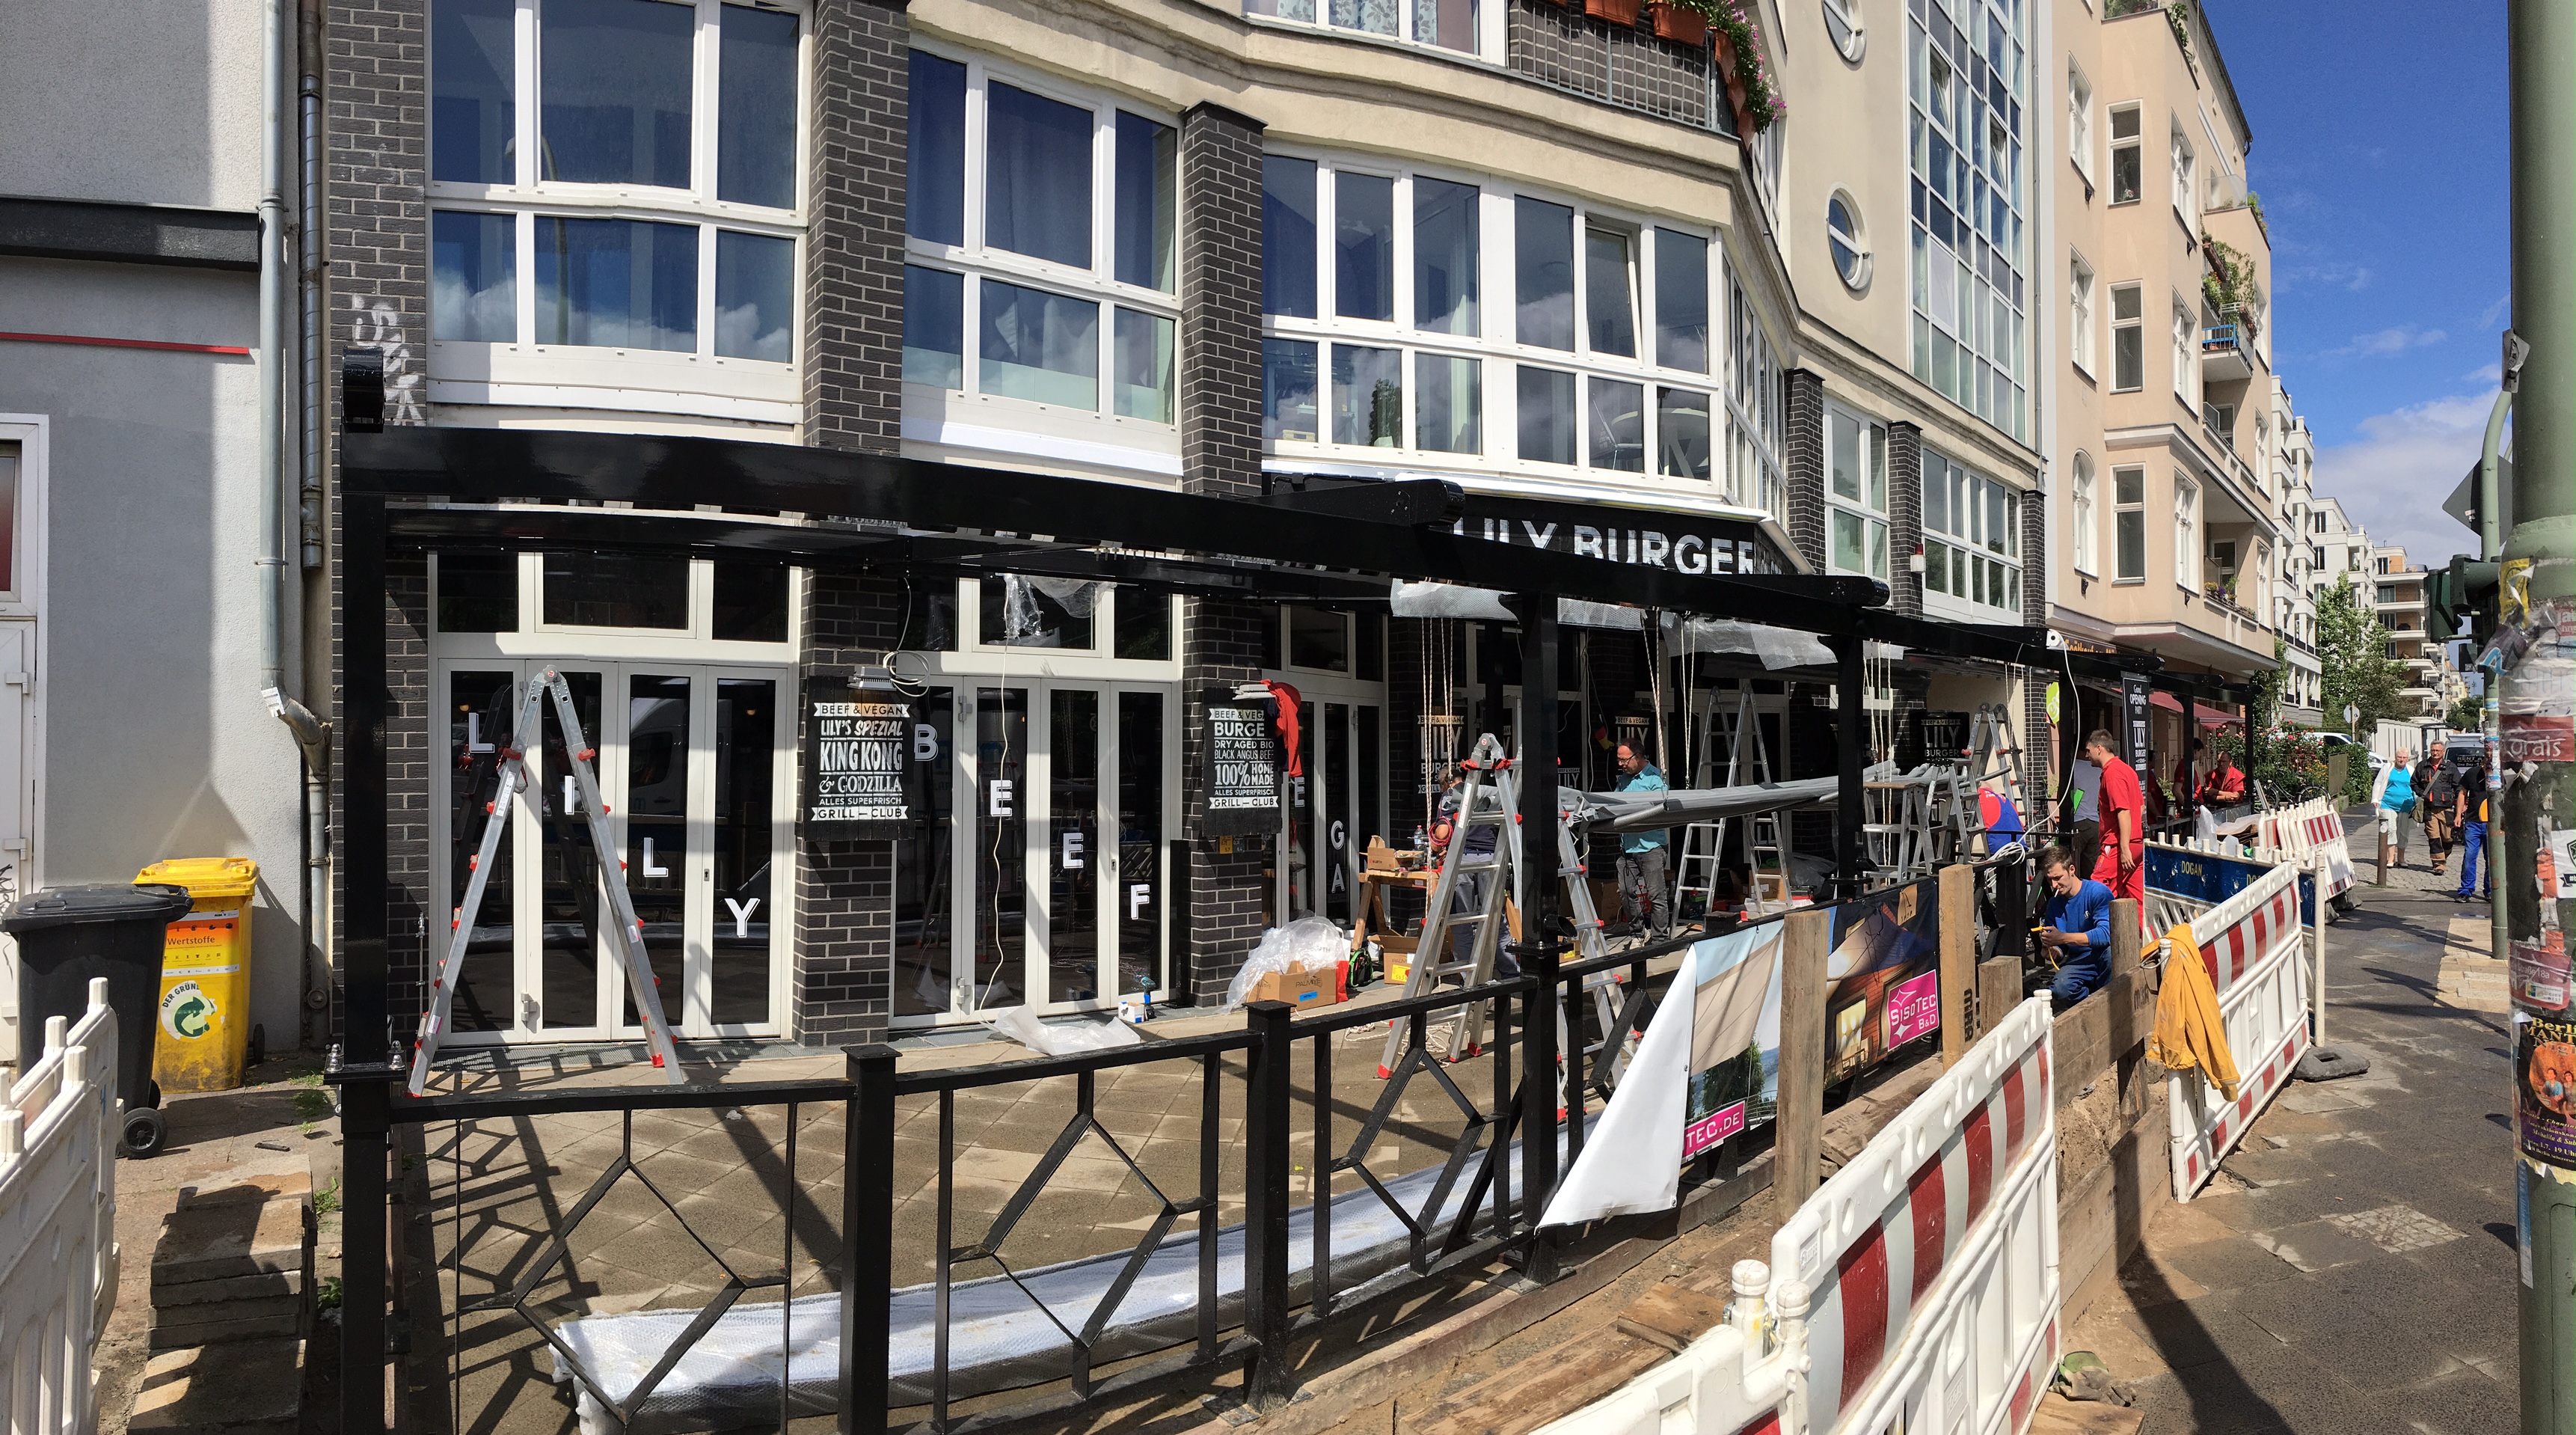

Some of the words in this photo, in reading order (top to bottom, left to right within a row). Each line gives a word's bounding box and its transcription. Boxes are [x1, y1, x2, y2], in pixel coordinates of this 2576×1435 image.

[2129, 694, 2146, 706] OPENING
[822, 706, 850, 714] BEEF
[853, 706, 860, 714] &
[864, 706, 903, 715] VEGAN
[1215, 710, 1236, 719] BEEF
[1237, 711, 1243, 719] &
[1245, 711, 1264, 720] VEG
[854, 720, 903, 736] SPEZIAL
[1215, 721, 1265, 737] BURGE
[1421, 726, 1462, 759] LILY
[1924, 726, 1960, 748] LILY
[2133, 727, 2146, 748] LILY
[1215, 740, 1232, 749] DRY
[1234, 740, 1257, 749] AGED
[1260, 741, 1274, 749] BIO
[1215, 750, 1235, 759] BLACK
[1237, 750, 1258, 759] ANGUS
[1260, 750, 1274, 759] BEEF
[1925, 749, 1960, 757] BURGER
[2135, 749, 2147, 758] BURGER
[1215, 762, 1251, 789] 100%
[1251, 763, 1274, 774] HOME
[1251, 774, 1274, 786] MADE
[837, 775, 903, 793] GODZILLA
[847, 797, 902, 806] SUPERFRISCH
[1214, 799, 1241, 807] GRILL
[818, 809, 855, 819] GRILL
[871, 808, 902, 818] CLUB
[2181, 860, 2203, 877] DOGAN
[168, 936, 215, 946] Wertstoffe
[162, 994, 175, 1009] DER
[1918, 1013, 1936, 1030] B&D
